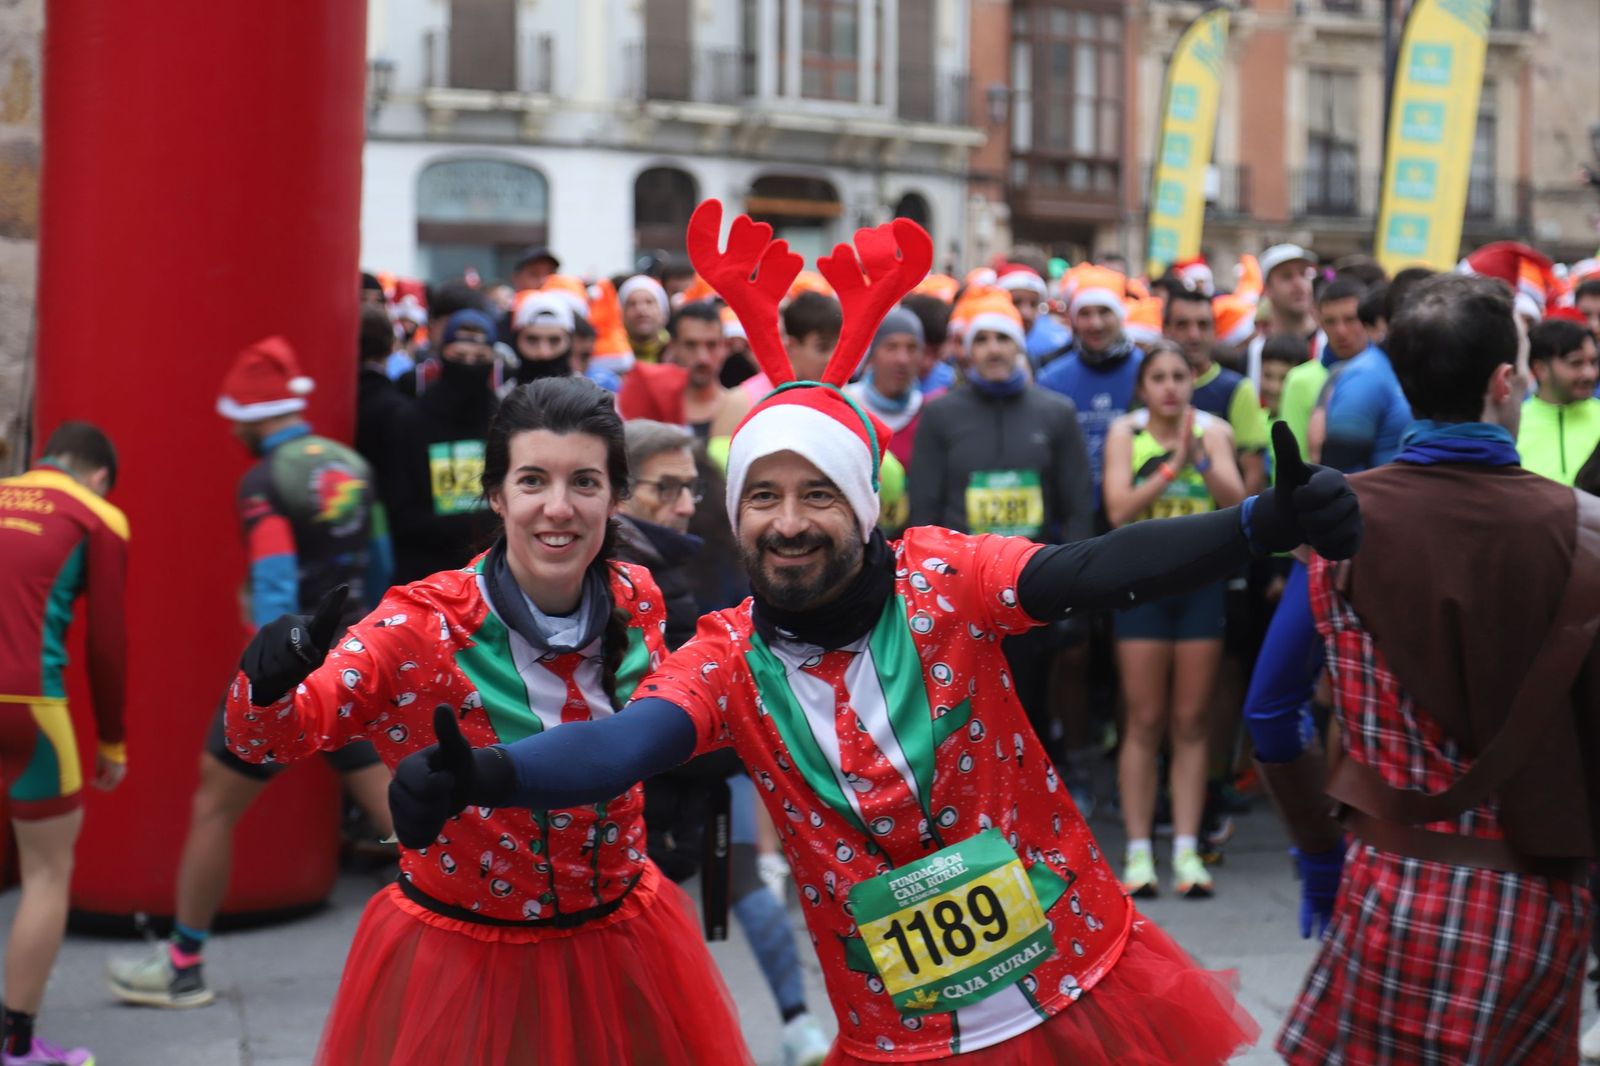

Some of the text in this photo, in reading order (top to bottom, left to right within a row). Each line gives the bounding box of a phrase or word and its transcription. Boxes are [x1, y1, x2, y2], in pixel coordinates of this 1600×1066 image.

[894, 863, 969, 901] CAJA RURAL
[883, 885, 1009, 975] 1189
[943, 941, 1047, 999] CAJA RURAL
